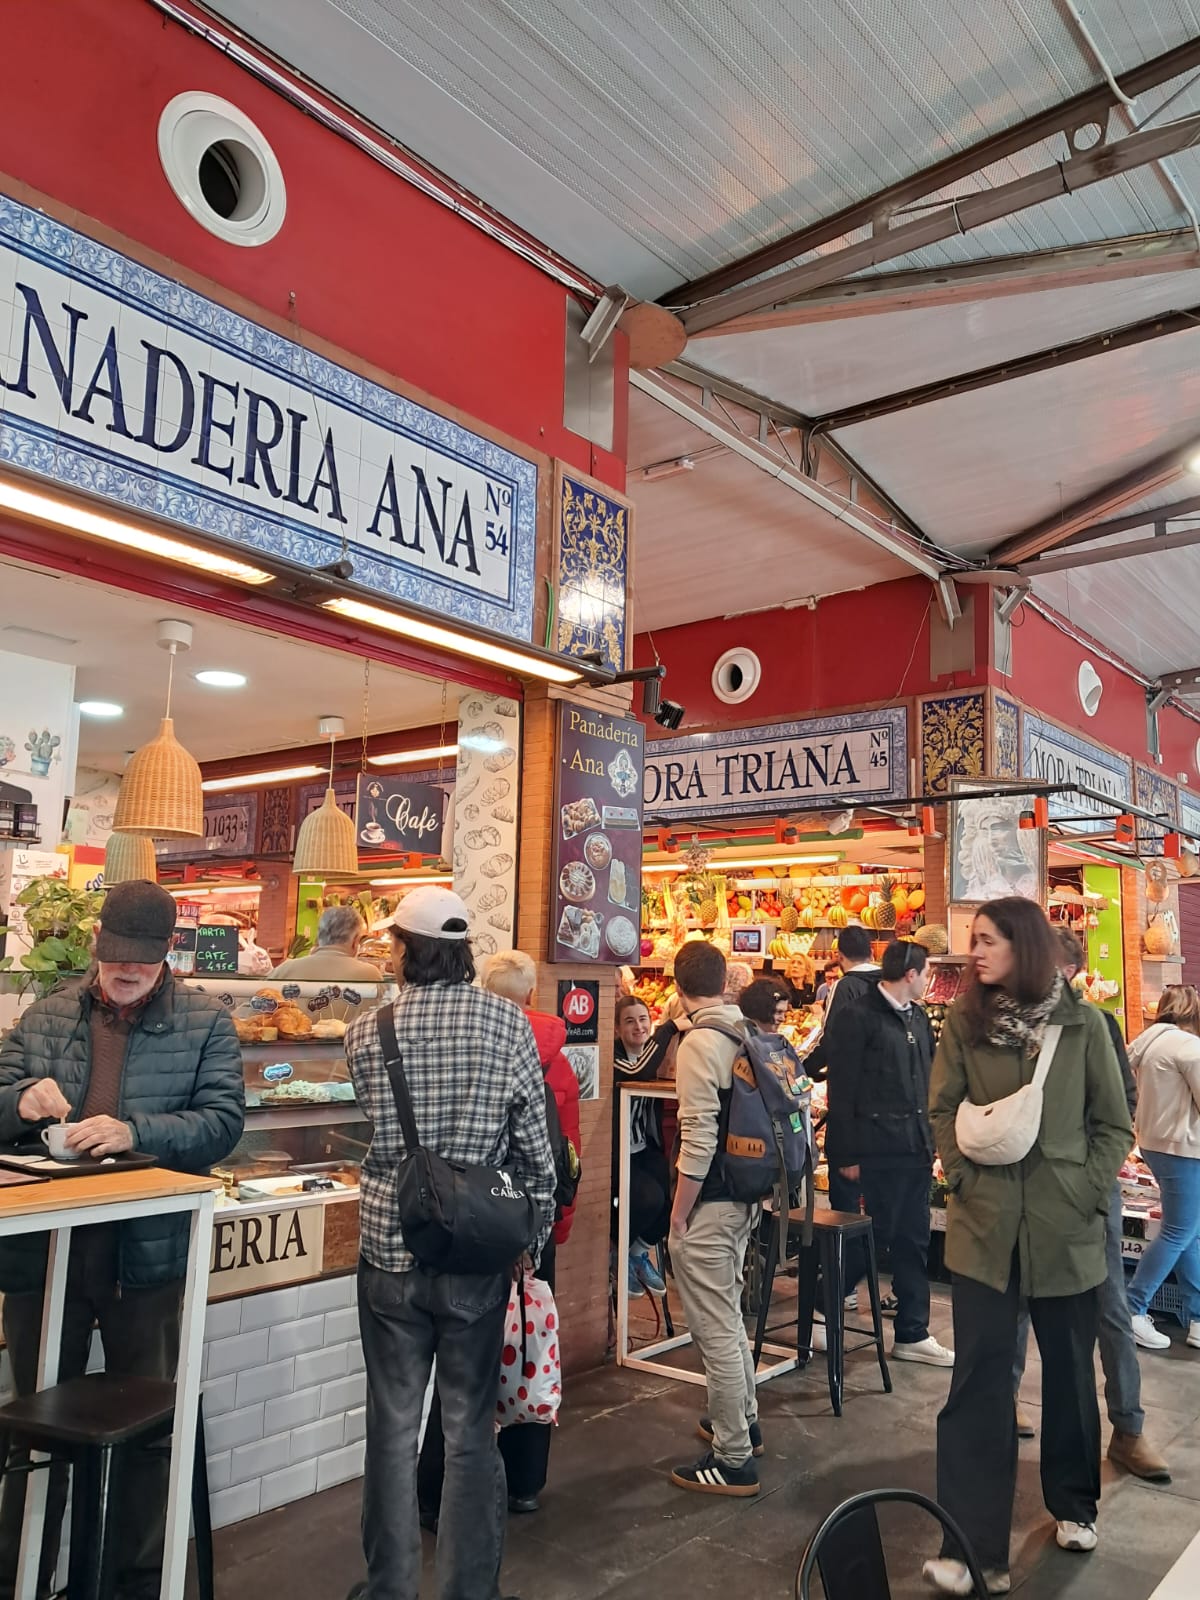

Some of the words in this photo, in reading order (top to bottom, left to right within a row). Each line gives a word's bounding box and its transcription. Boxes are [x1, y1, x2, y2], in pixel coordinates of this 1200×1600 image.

[366, 455, 481, 577] ANA
[484, 524, 508, 556] 54
[569, 710, 638, 747] Panadería
[569, 748, 605, 777] Ana
[643, 759, 707, 804] ORA
[715, 741, 860, 797] TRIANA
[869, 750, 888, 768] 45
[385, 794, 439, 838] Café
[568, 995, 589, 1015] AB
[210, 1209, 308, 1274] ERIA
[1120, 1240, 1145, 1255] erl
